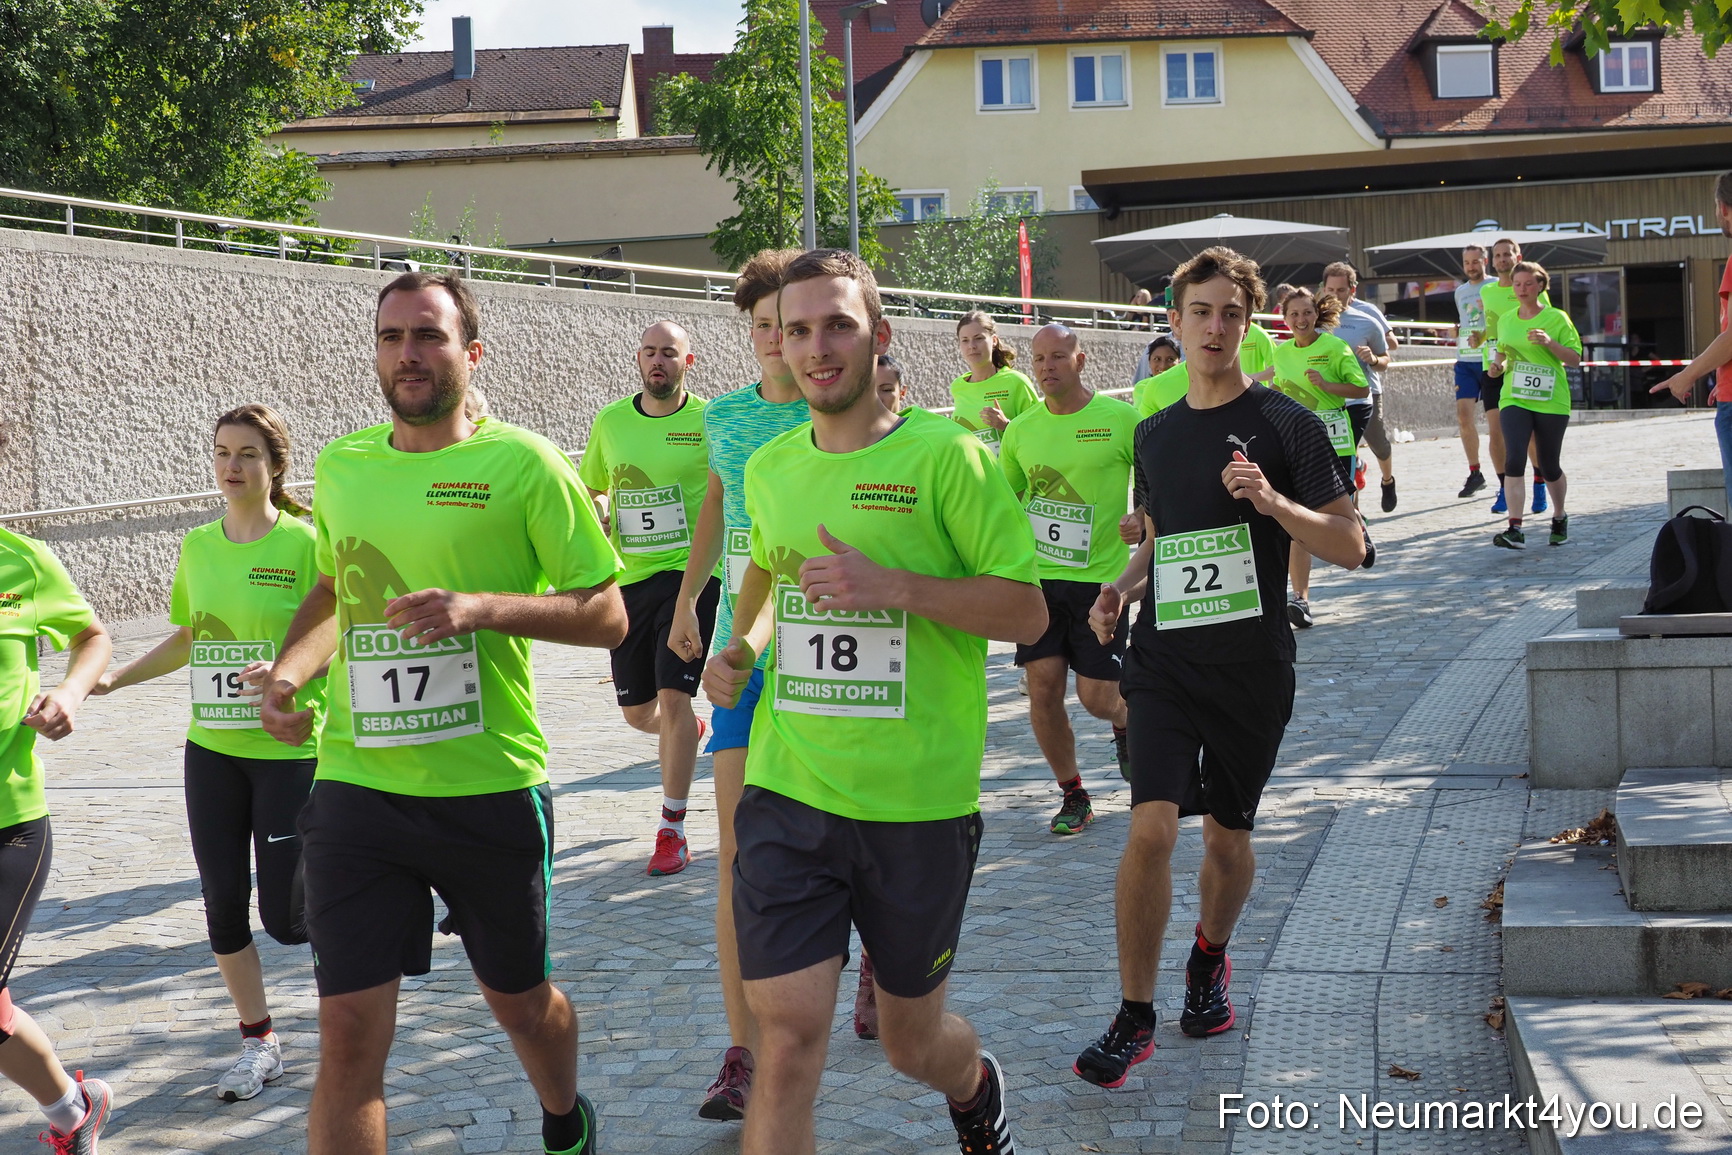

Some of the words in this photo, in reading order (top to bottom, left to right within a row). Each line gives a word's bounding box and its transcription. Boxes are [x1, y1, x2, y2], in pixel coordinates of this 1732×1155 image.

[1517, 363, 1551, 375] BOCK
[1524, 376, 1541, 388] 50
[432, 482, 490, 491] NEUMARKTER
[855, 483, 917, 495] NEUMARKTER
[426, 491, 491, 501] ELEMENTELAUF
[620, 488, 676, 507] BOCK
[850, 493, 918, 505] ELEMENTELAUF
[1030, 500, 1086, 522] BOCK
[641, 512, 655, 530] 5
[626, 532, 681, 543] CHRISTOPHER
[1049, 523, 1061, 542] 6
[1037, 543, 1073, 559] HARALD
[1160, 530, 1243, 561] BOCK
[248, 574, 296, 583] ELEMENTELAUF
[252, 567, 296, 576] NEUMARKTER
[1182, 563, 1223, 594] 22
[1182, 599, 1230, 616] LOUIS
[194, 645, 264, 664] BOCK
[808, 633, 858, 672] 18
[211, 672, 244, 698] 19
[382, 666, 430, 703] 17
[787, 680, 888, 700] CHRISTOPH
[200, 707, 261, 718] MARLENE
[362, 708, 466, 732] SEBASTIAN
[932, 948, 951, 969] JAKO
